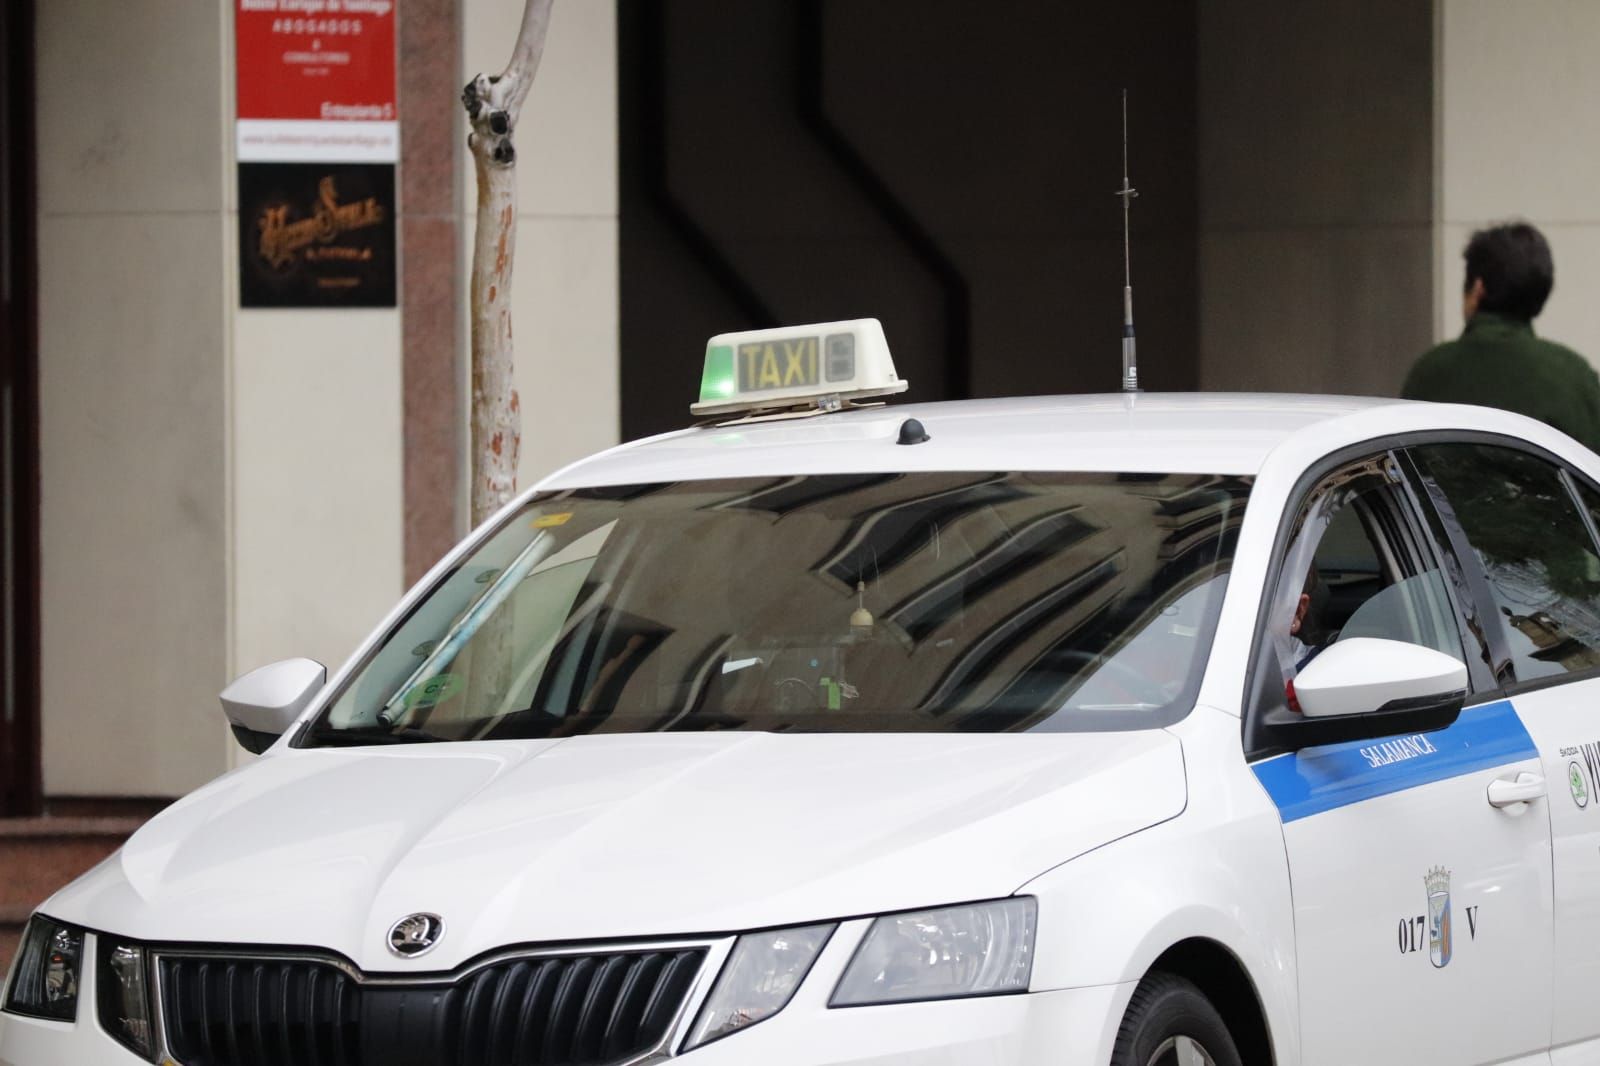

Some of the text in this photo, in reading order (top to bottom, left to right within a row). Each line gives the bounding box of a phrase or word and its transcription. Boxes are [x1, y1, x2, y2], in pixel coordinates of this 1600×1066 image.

[272, 18, 362, 34] ABOGADOS
[741, 339, 816, 388] TAXI
[1360, 733, 1437, 768] SALAMANCA
[1398, 905, 1479, 954] 017 V
